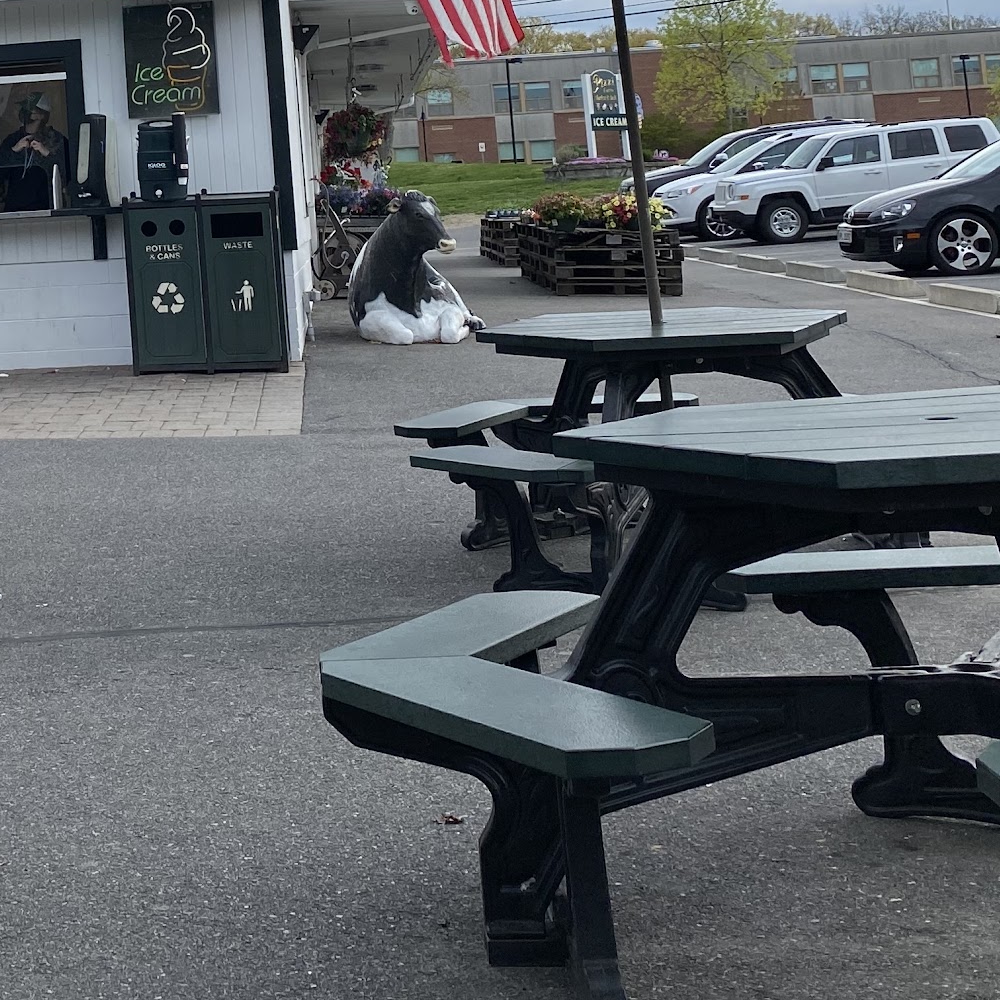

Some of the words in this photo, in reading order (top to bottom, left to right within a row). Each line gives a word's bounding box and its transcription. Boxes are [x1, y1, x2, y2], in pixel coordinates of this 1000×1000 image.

[135, 63, 165, 82] Ice
[131, 86, 201, 105] Cream
[593, 118, 605, 126] ICE
[606, 117, 628, 126] CREAM
[145, 243, 183, 252] BOTTLES
[223, 241, 253, 249] WASTE
[157, 252, 181, 260] CANS
